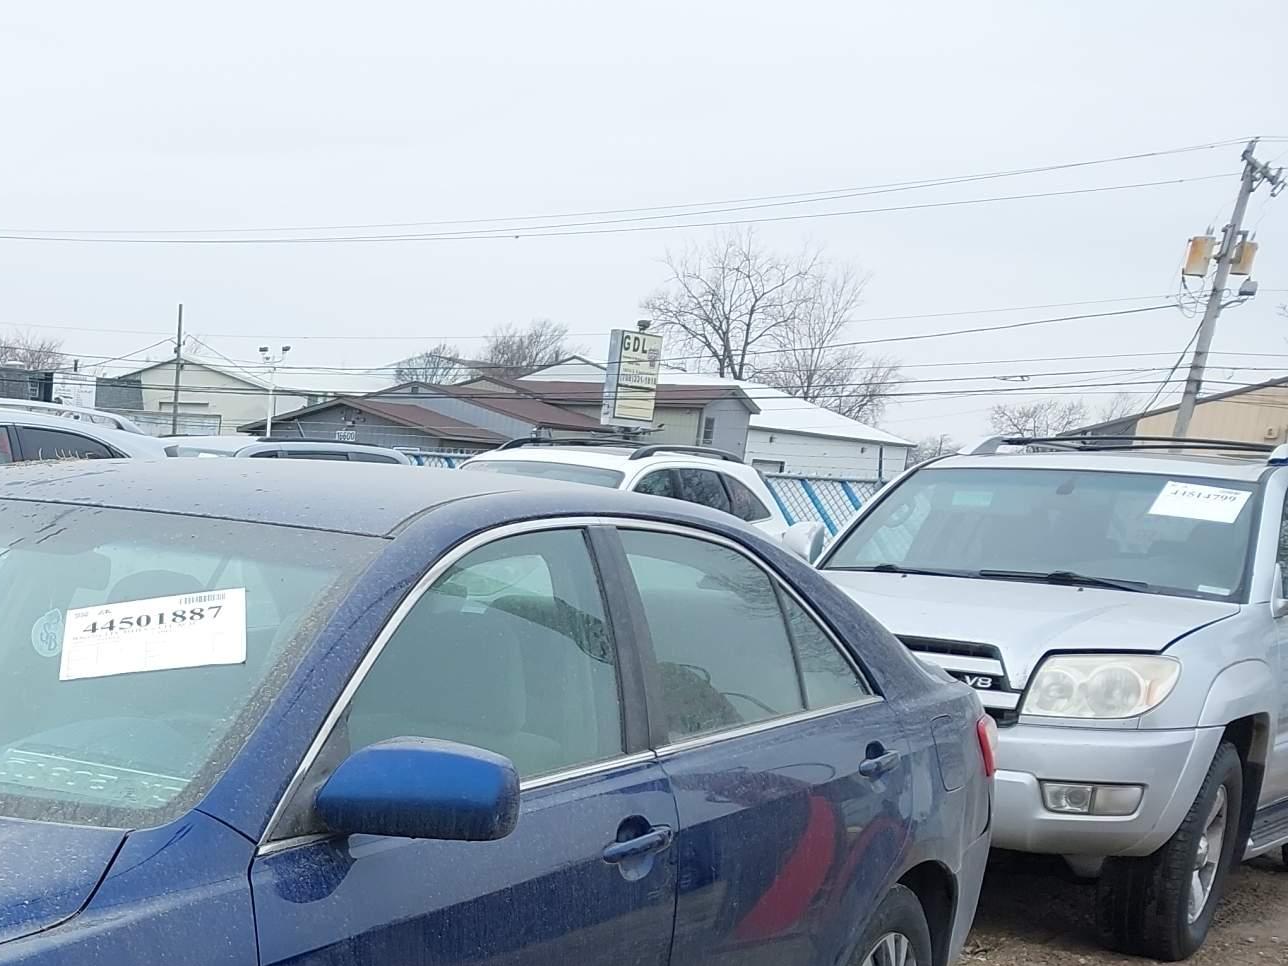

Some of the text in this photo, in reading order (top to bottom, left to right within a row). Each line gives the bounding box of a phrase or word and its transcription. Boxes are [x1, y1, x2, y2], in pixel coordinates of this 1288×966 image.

[623, 334, 648, 354] GDL
[82, 605, 223, 634] 44501887
[964, 675, 993, 688] V8
